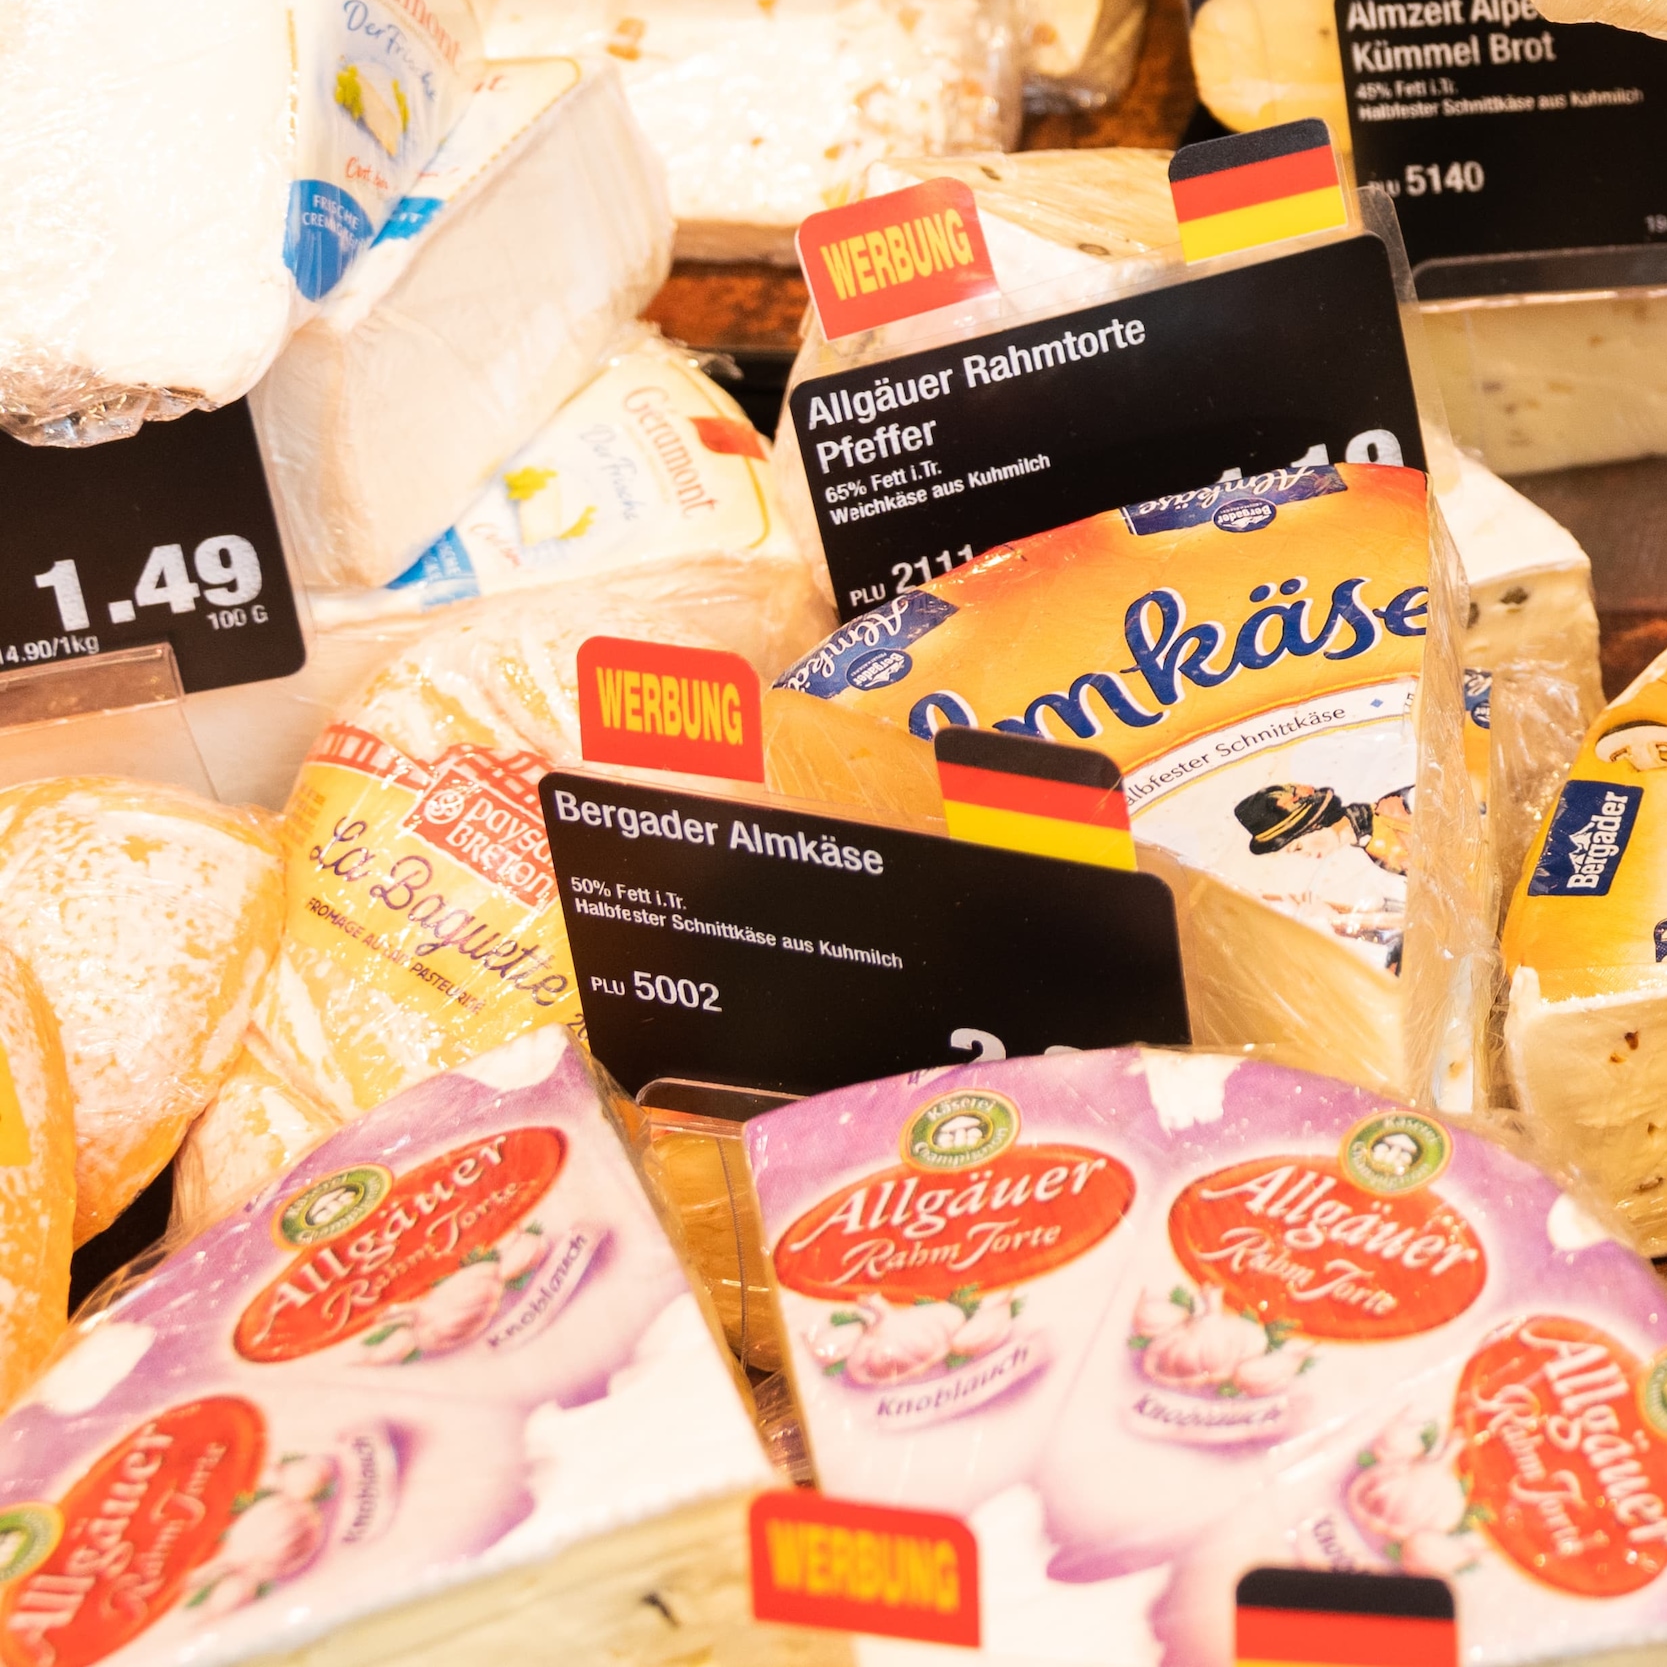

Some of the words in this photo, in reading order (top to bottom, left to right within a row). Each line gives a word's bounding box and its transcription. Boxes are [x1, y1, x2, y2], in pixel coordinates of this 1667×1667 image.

[1352, 36, 1480, 72] Kümmel
[1490, 33, 1554, 63] Brot
[1406, 162, 1484, 195] 5140
[820, 209, 974, 300] WERBUNG
[809, 369, 953, 430] Allgäuer
[963, 319, 1145, 388] Rahmtorte
[816, 420, 936, 473] Pfeffer
[830, 489, 927, 525] Weichkäse
[932, 479, 964, 498] aus
[968, 454, 1050, 488] Kuhmilch
[35, 535, 262, 631] 1.49
[595, 667, 744, 746] WERBUNG
[555, 790, 718, 845] Bergader
[730, 821, 883, 874] Almkäse
[1567, 790, 1628, 890] Bergader
[575, 898, 666, 926] Halbfester
[672, 914, 776, 946] Schnittkäse
[782, 937, 814, 953] aus
[820, 940, 902, 968] Kuhmilch
[634, 971, 722, 1011] 5002
[765, 1517, 961, 1614] WERBUNG
